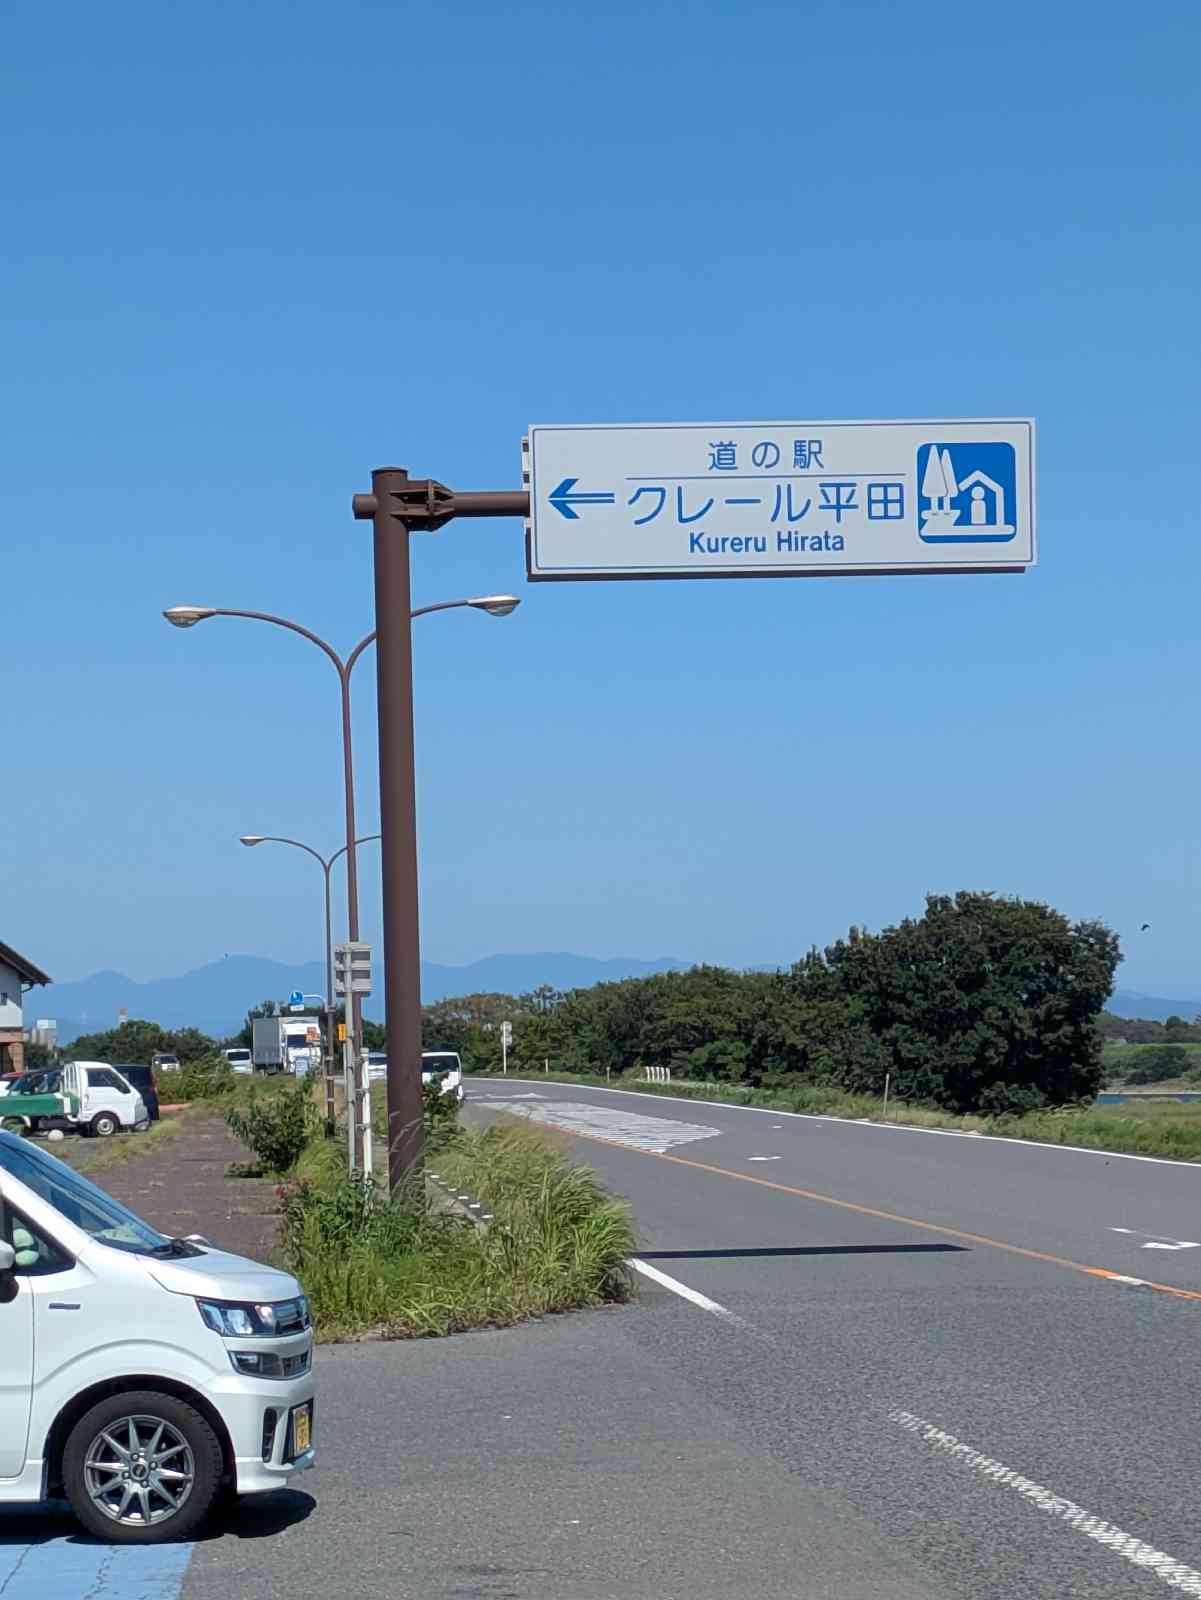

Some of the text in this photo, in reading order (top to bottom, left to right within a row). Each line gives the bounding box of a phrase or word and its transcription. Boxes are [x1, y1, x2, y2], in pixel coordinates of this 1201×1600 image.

[708, 440, 824, 471] 道の駅
[627, 482, 905, 526] クレール平田
[690, 530, 845, 554] Kureru Hirata
